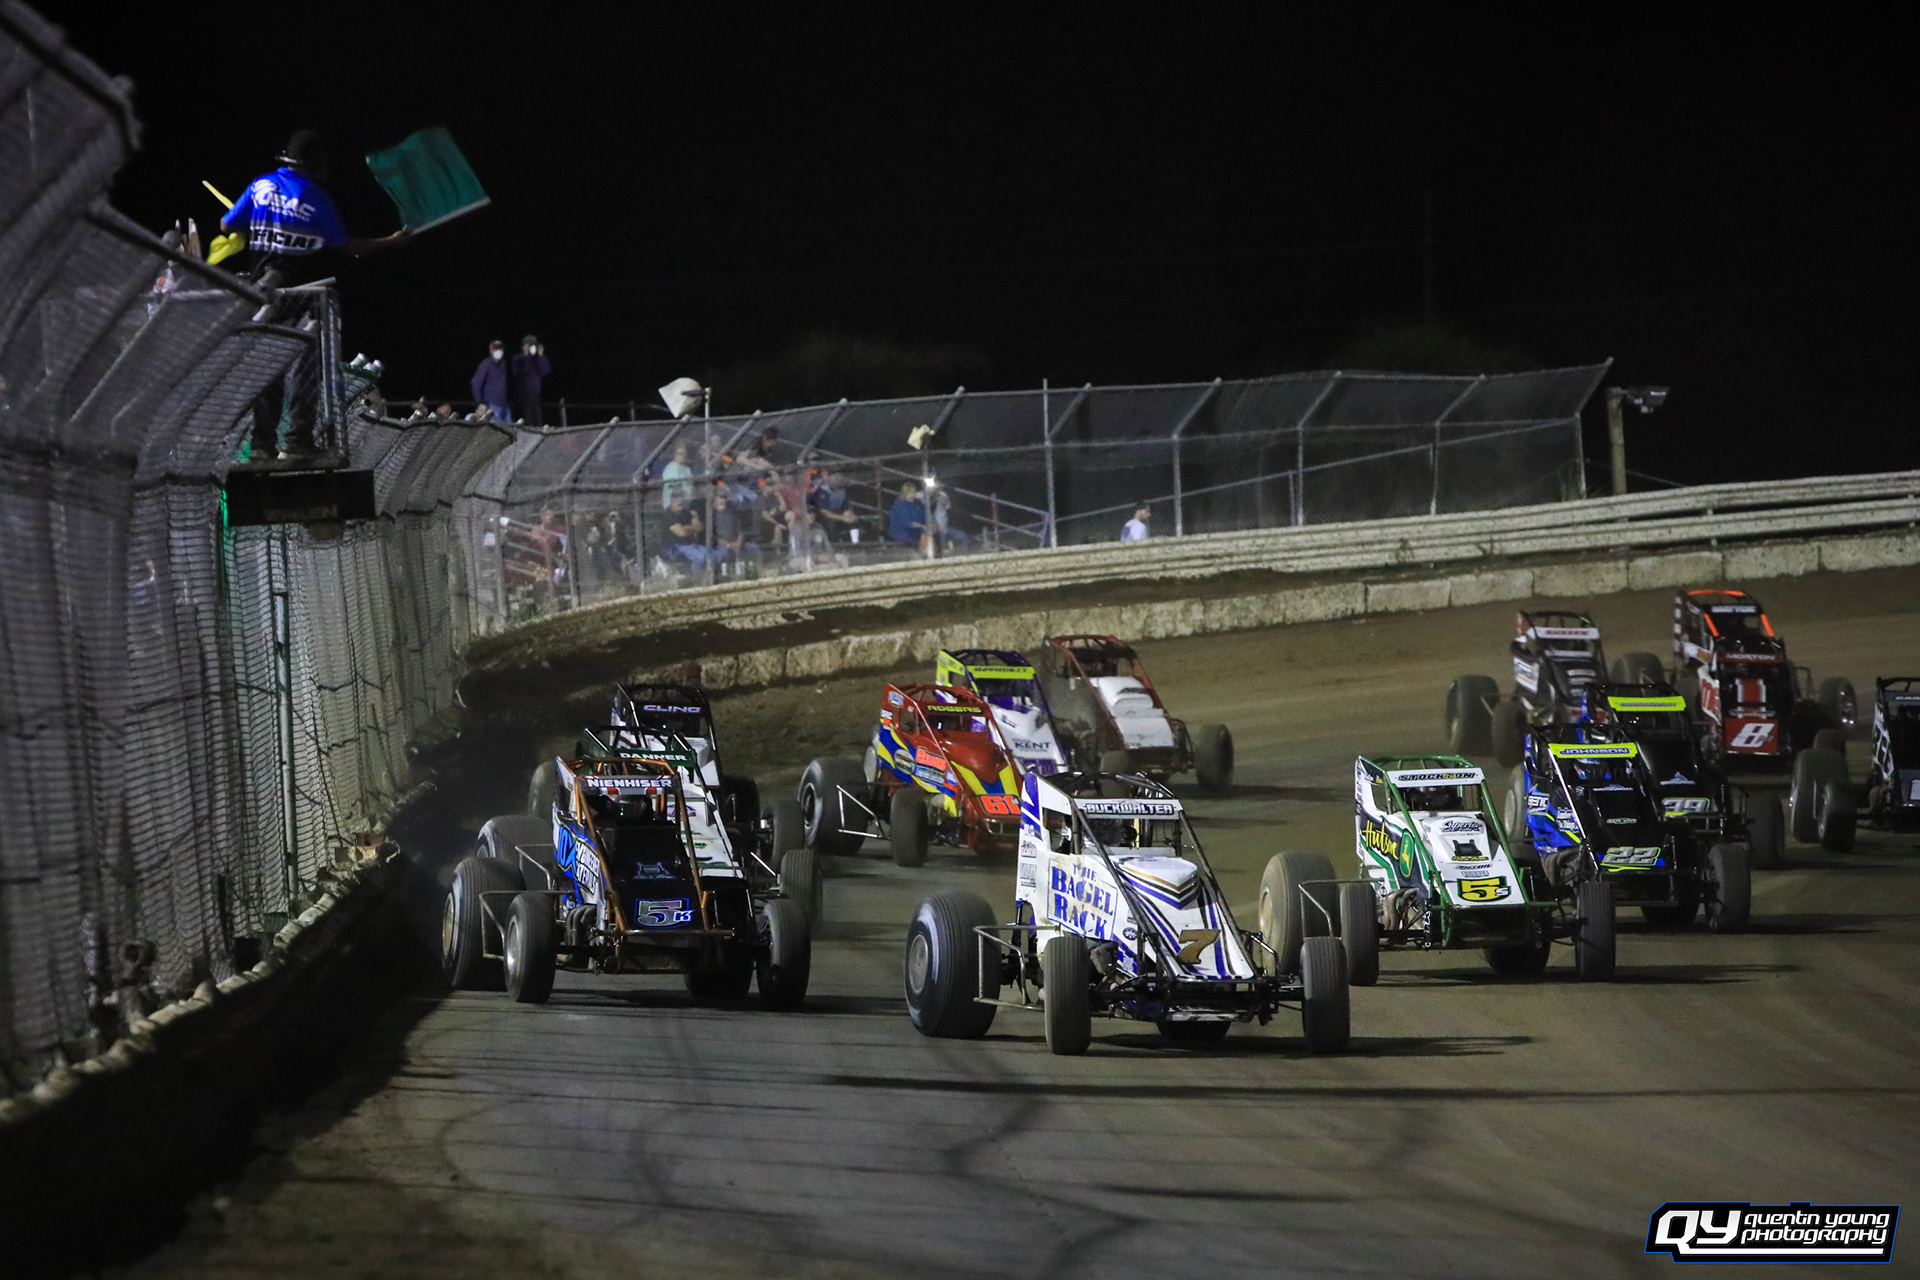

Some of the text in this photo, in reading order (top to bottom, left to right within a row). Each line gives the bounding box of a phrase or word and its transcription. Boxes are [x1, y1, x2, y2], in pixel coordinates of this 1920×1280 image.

[926, 704, 982, 713] ROGERS
[1015, 741, 1051, 749] KENT
[619, 752, 688, 761] DANNER
[586, 779, 672, 788] NIENHISER
[1086, 803, 1174, 815] BUCKWALTER
[1361, 820, 1400, 860] Hutson
[1602, 847, 1660, 866] 22
[1051, 866, 1114, 917] BAGEL
[1053, 893, 1108, 941] RACK
[1175, 929, 1221, 964] 7
